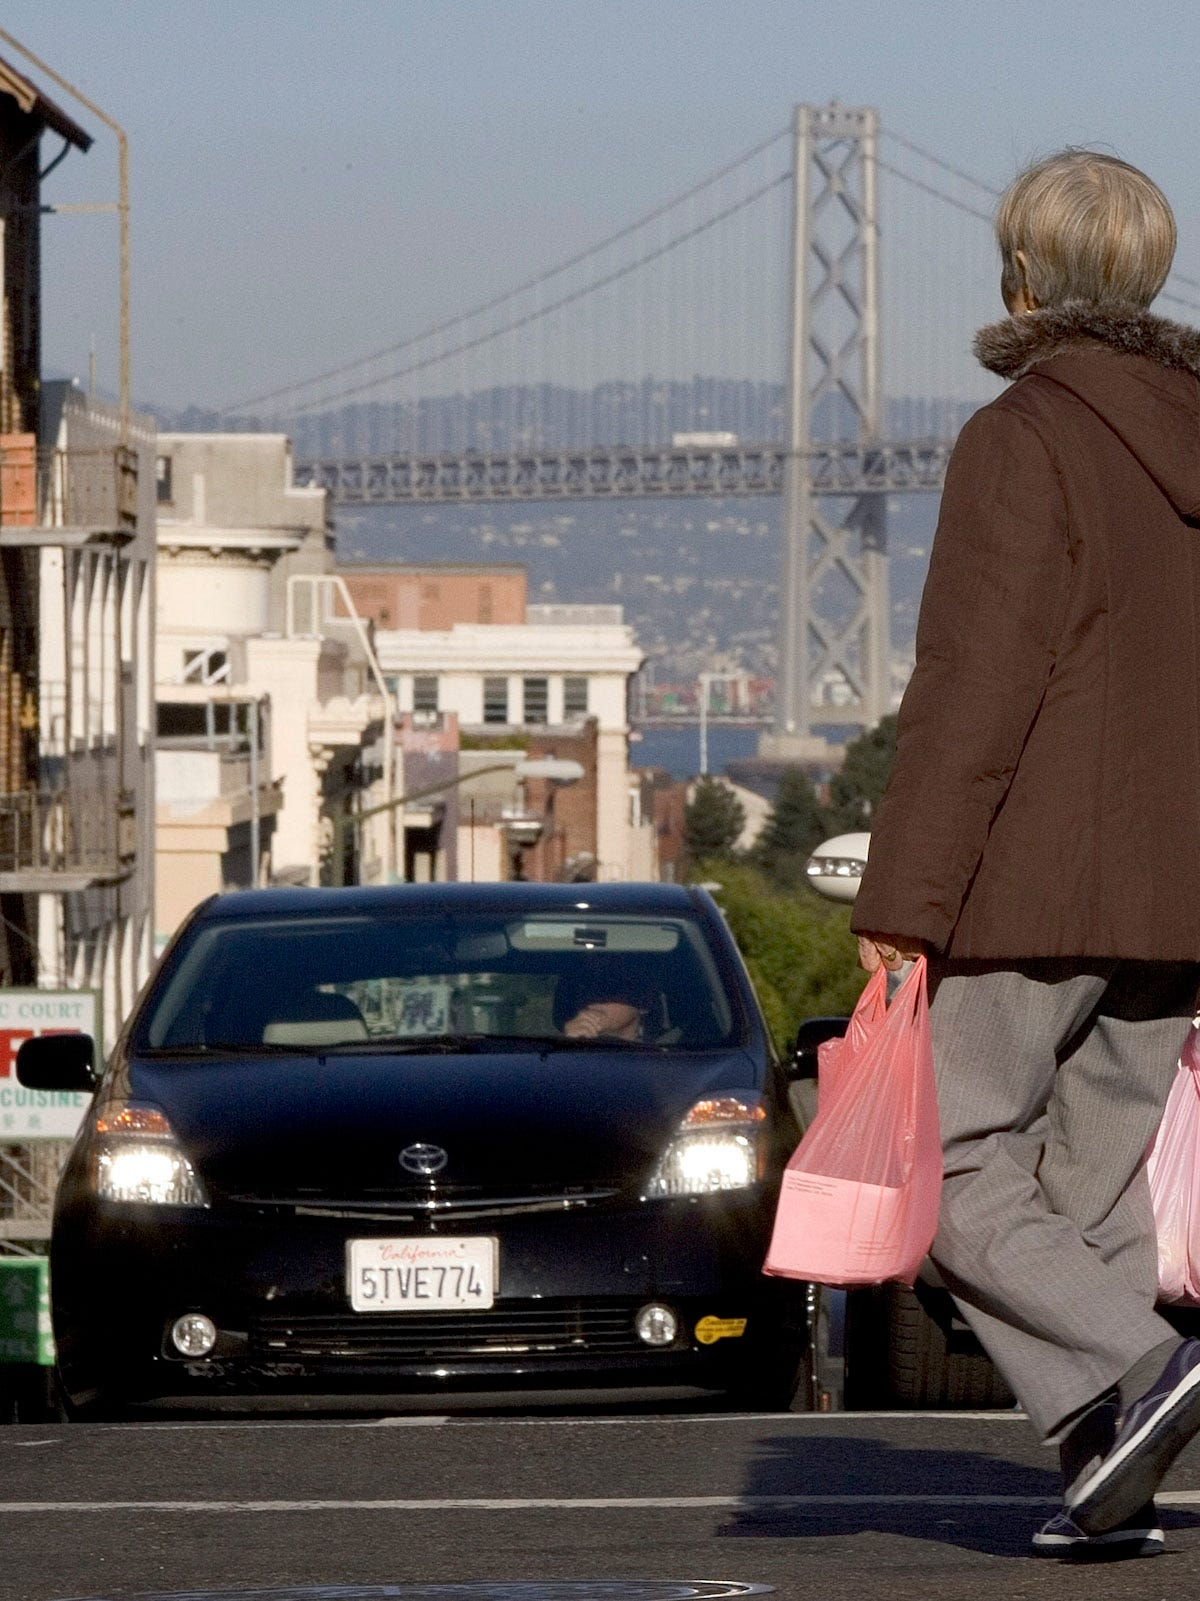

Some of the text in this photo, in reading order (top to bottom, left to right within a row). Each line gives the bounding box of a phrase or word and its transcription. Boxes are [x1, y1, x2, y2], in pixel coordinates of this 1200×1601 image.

[19, 1002, 83, 1018] COURT
[1, 1088, 84, 1107] CUISINE
[379, 1244, 466, 1263] California
[361, 1266, 483, 1299] 5TVE774
